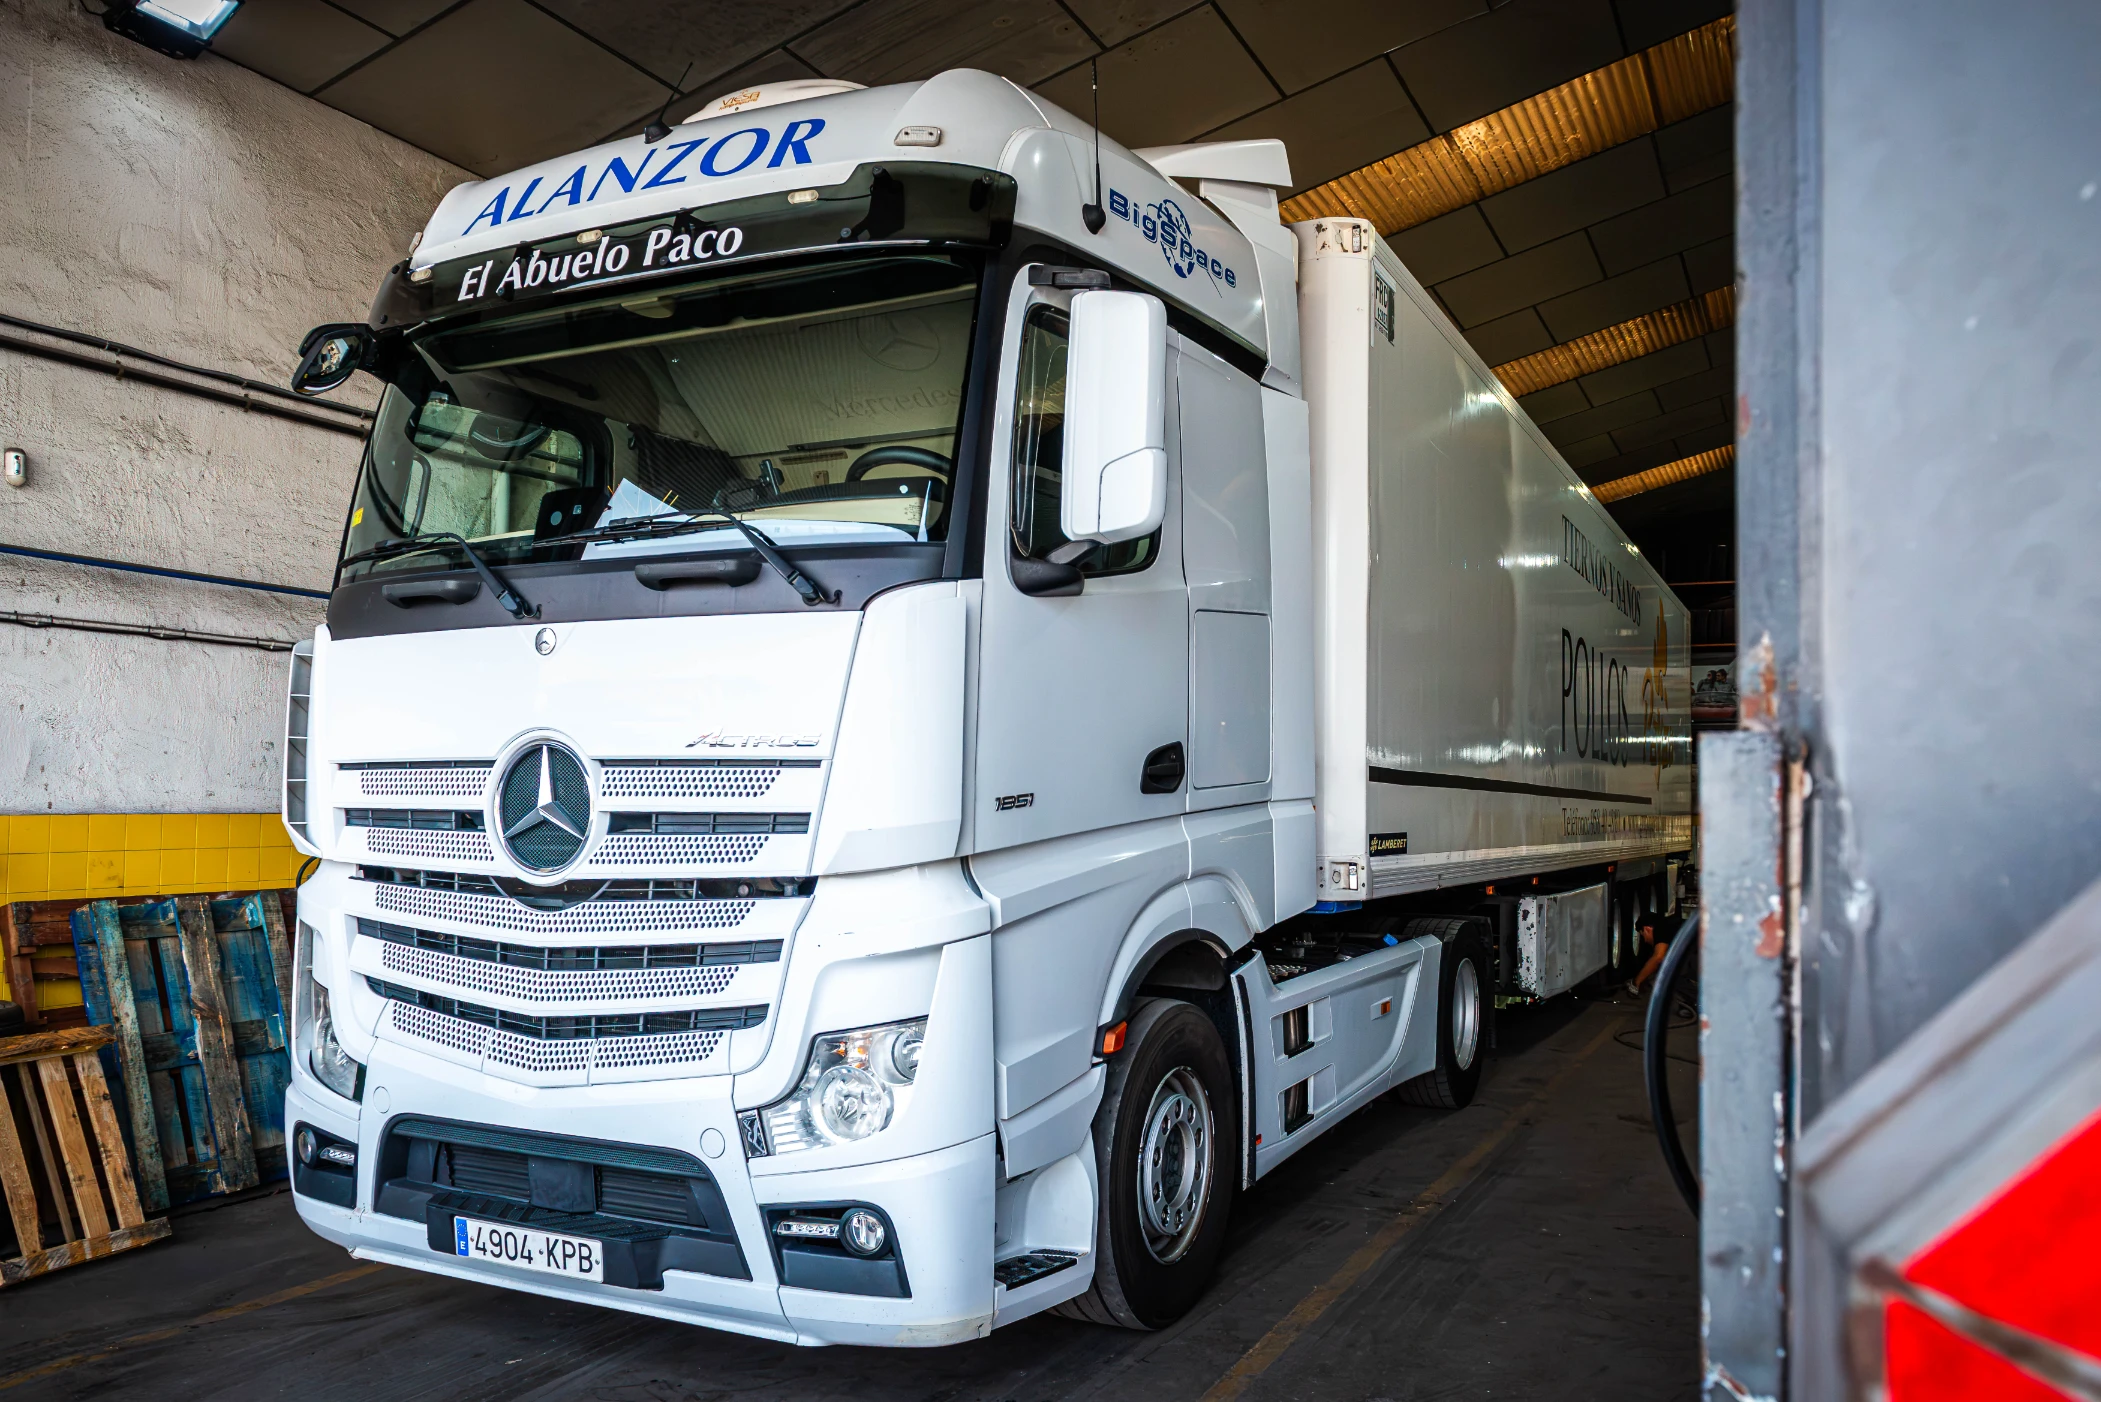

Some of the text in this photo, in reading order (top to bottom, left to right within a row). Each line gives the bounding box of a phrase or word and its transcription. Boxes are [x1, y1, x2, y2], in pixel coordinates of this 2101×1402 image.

[462, 117, 827, 236] ALANZOR
[457, 259, 494, 301] El
[642, 227, 744, 266] Paco
[1561, 513, 1641, 628] TIERNOS Y SANOS
[1561, 626, 1630, 768] POLLOS
[994, 792, 1035, 812] 1851
[1378, 838, 1407, 850] LAMBERET
[460, 1240, 467, 1251] E
[474, 1226, 594, 1274] 4904 KPB
